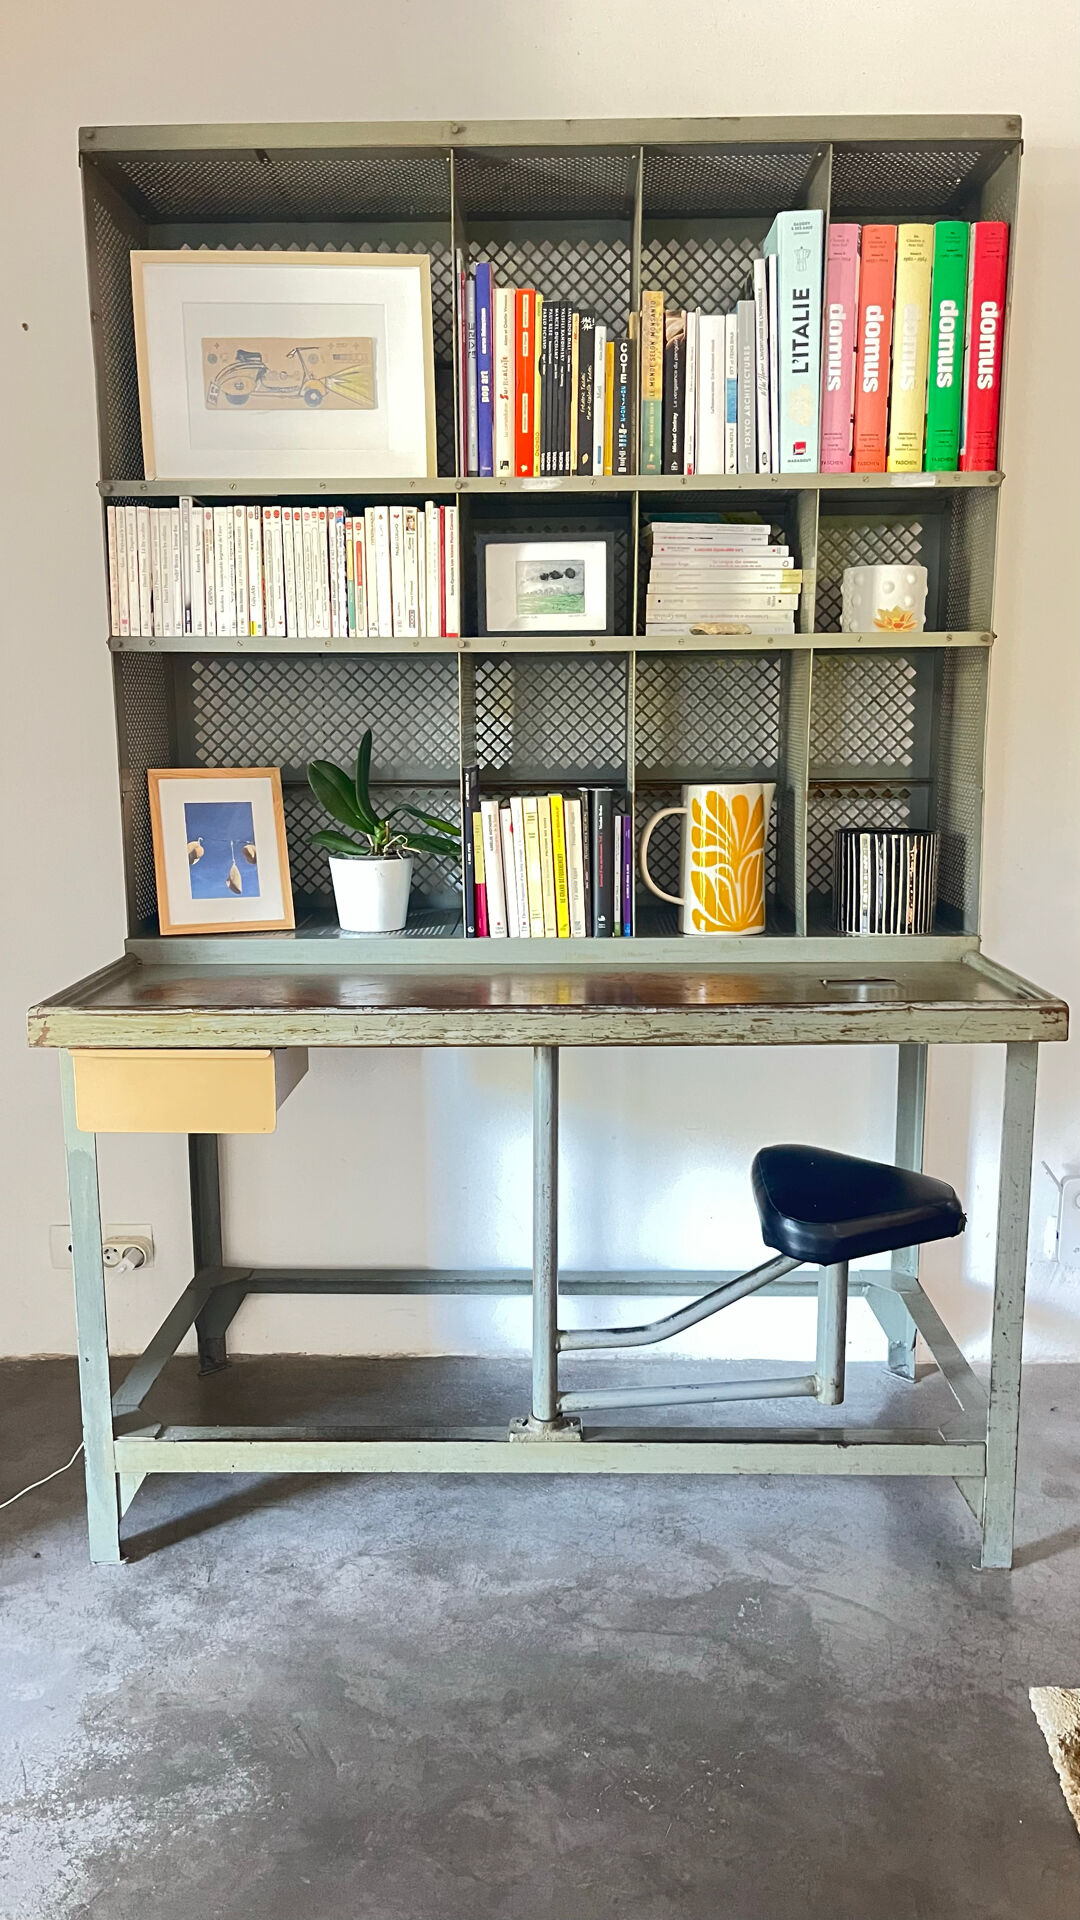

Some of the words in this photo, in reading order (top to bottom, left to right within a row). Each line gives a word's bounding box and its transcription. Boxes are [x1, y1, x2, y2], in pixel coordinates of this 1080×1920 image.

[792, 288, 809, 374] L'ITALIE
[827, 303, 847, 392] domus
[863, 305, 884, 394] domus
[900, 303, 920, 392] domus
[936, 300, 959, 389] domus
[976, 301, 999, 390] domus
[480, 370, 488, 384] art
[481, 385, 489, 403] pop
[743, 345, 751, 417] ARCHITECTURES
[743, 418, 751, 449] TOKYO
